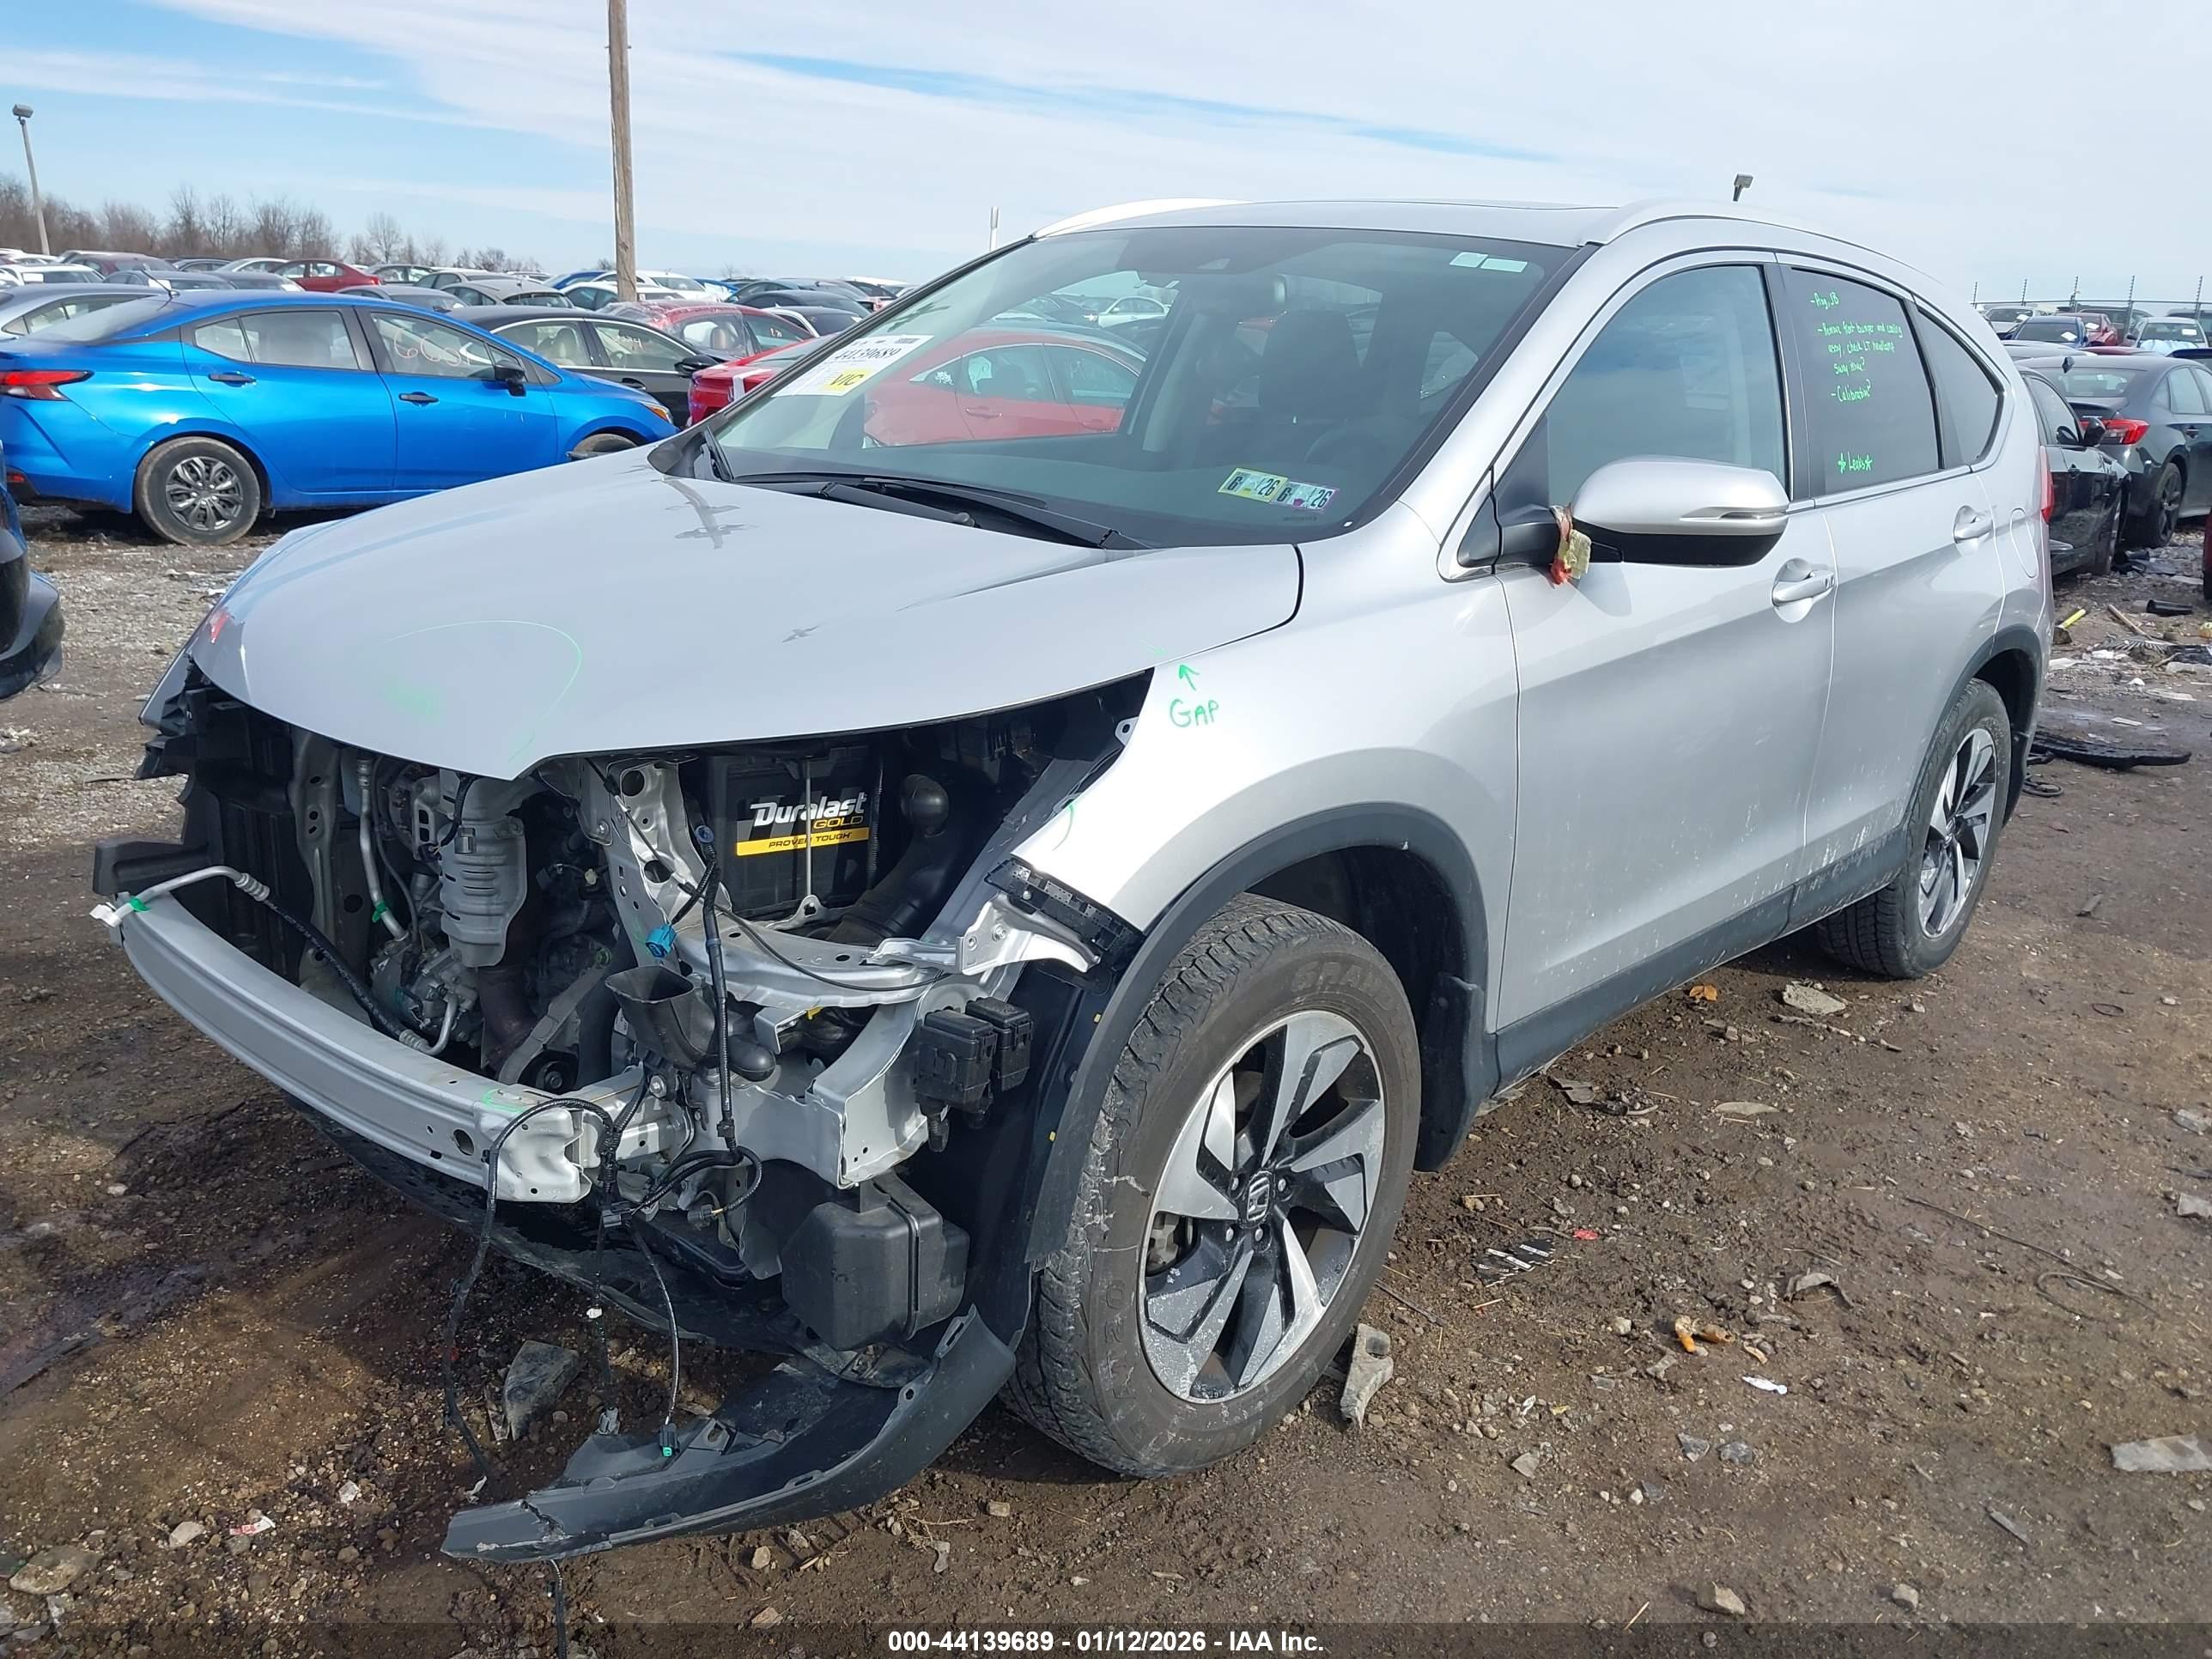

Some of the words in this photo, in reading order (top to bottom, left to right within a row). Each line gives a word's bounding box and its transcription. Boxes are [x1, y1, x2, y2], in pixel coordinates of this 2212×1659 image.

[831, 374, 864, 386] VIC
[1258, 478, 1280, 496] 26
[1310, 489, 1332, 507] 26
[1169, 698, 1219, 728] GAP
[749, 792, 867, 827] Duralast
[812, 815, 864, 830] GOLD
[816, 831, 852, 843] TOUGH
